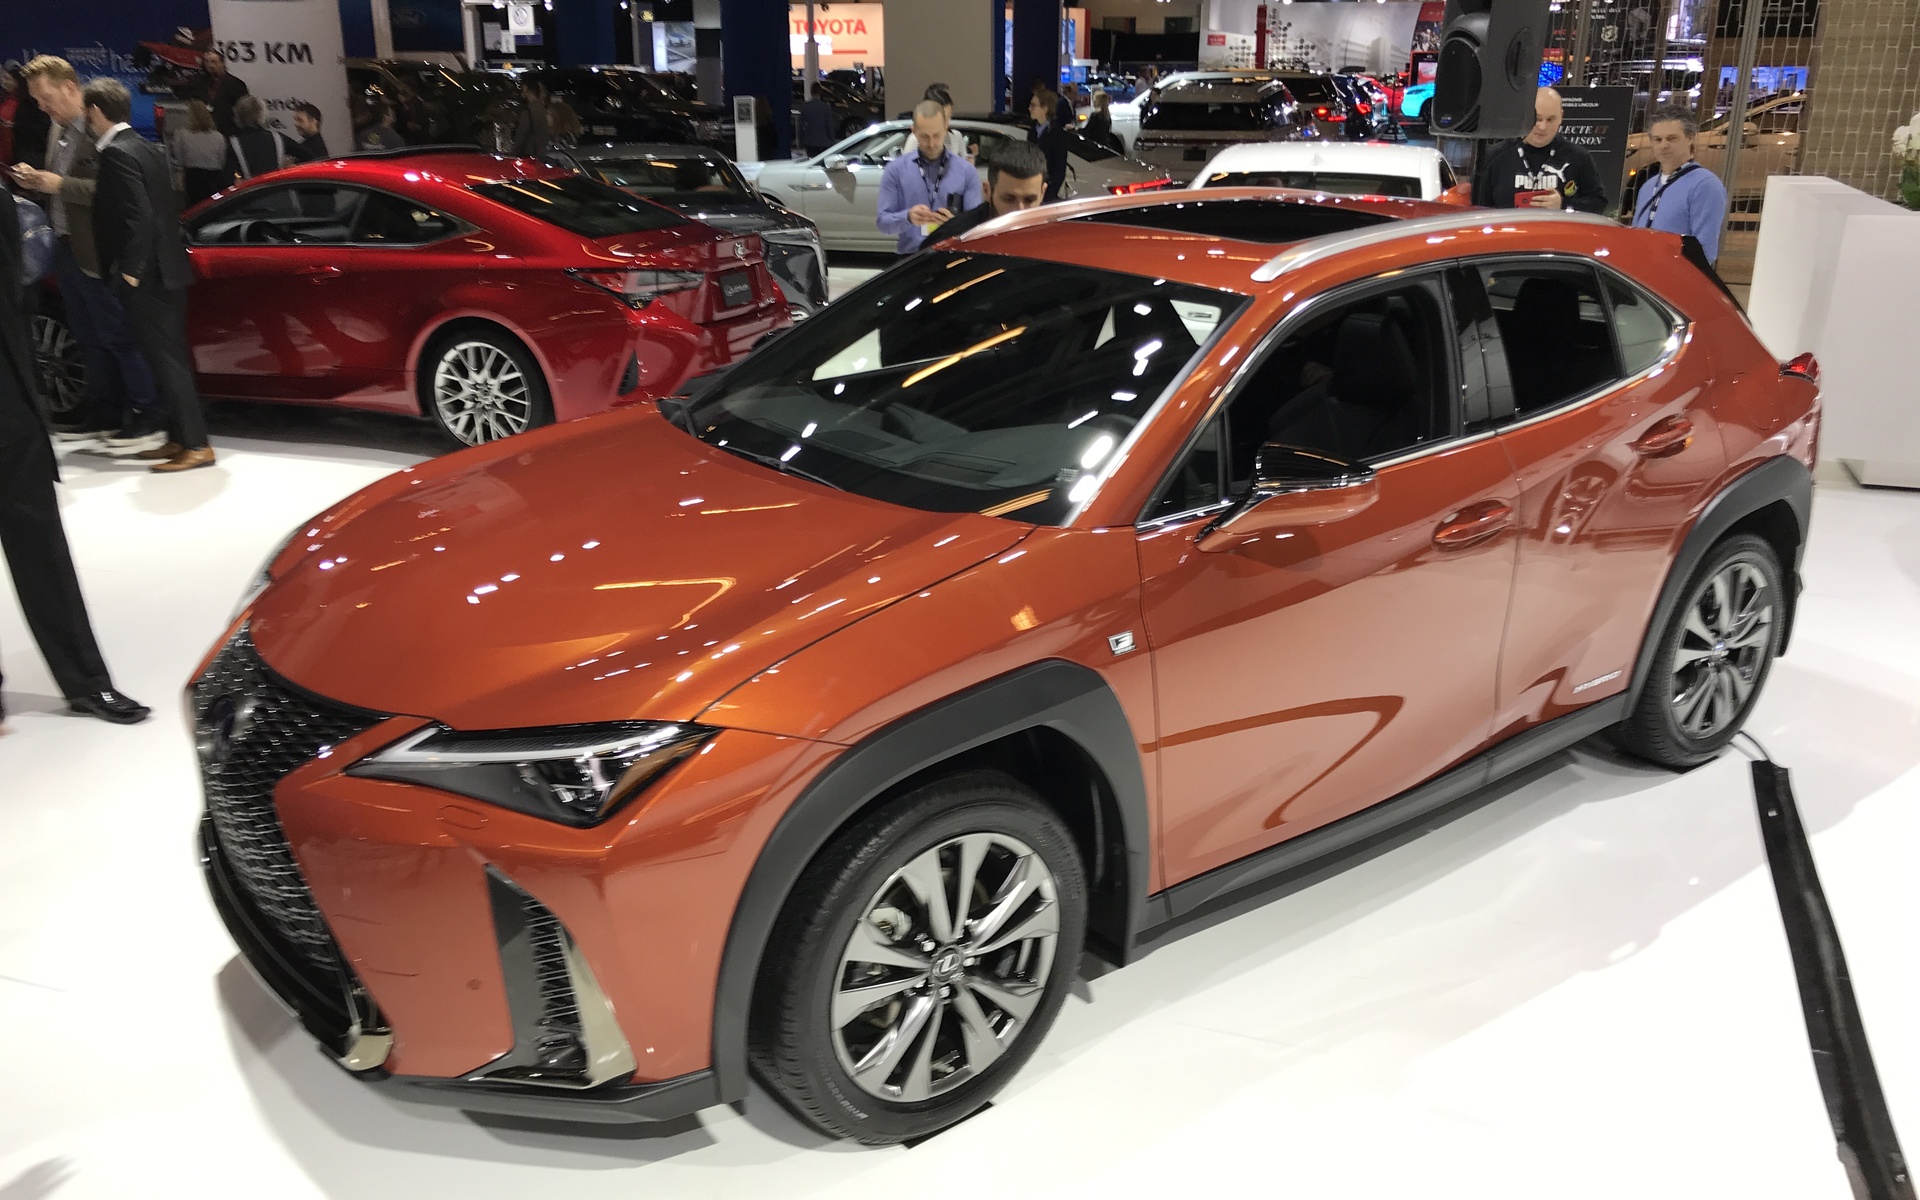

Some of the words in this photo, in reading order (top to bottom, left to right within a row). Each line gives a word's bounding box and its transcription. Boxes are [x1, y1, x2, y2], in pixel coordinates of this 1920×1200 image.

[792, 18, 868, 35] TOYOTA
[263, 41, 314, 65] KM
[1558, 125, 1593, 134] LECTE
[1514, 174, 1558, 190] PUMA
